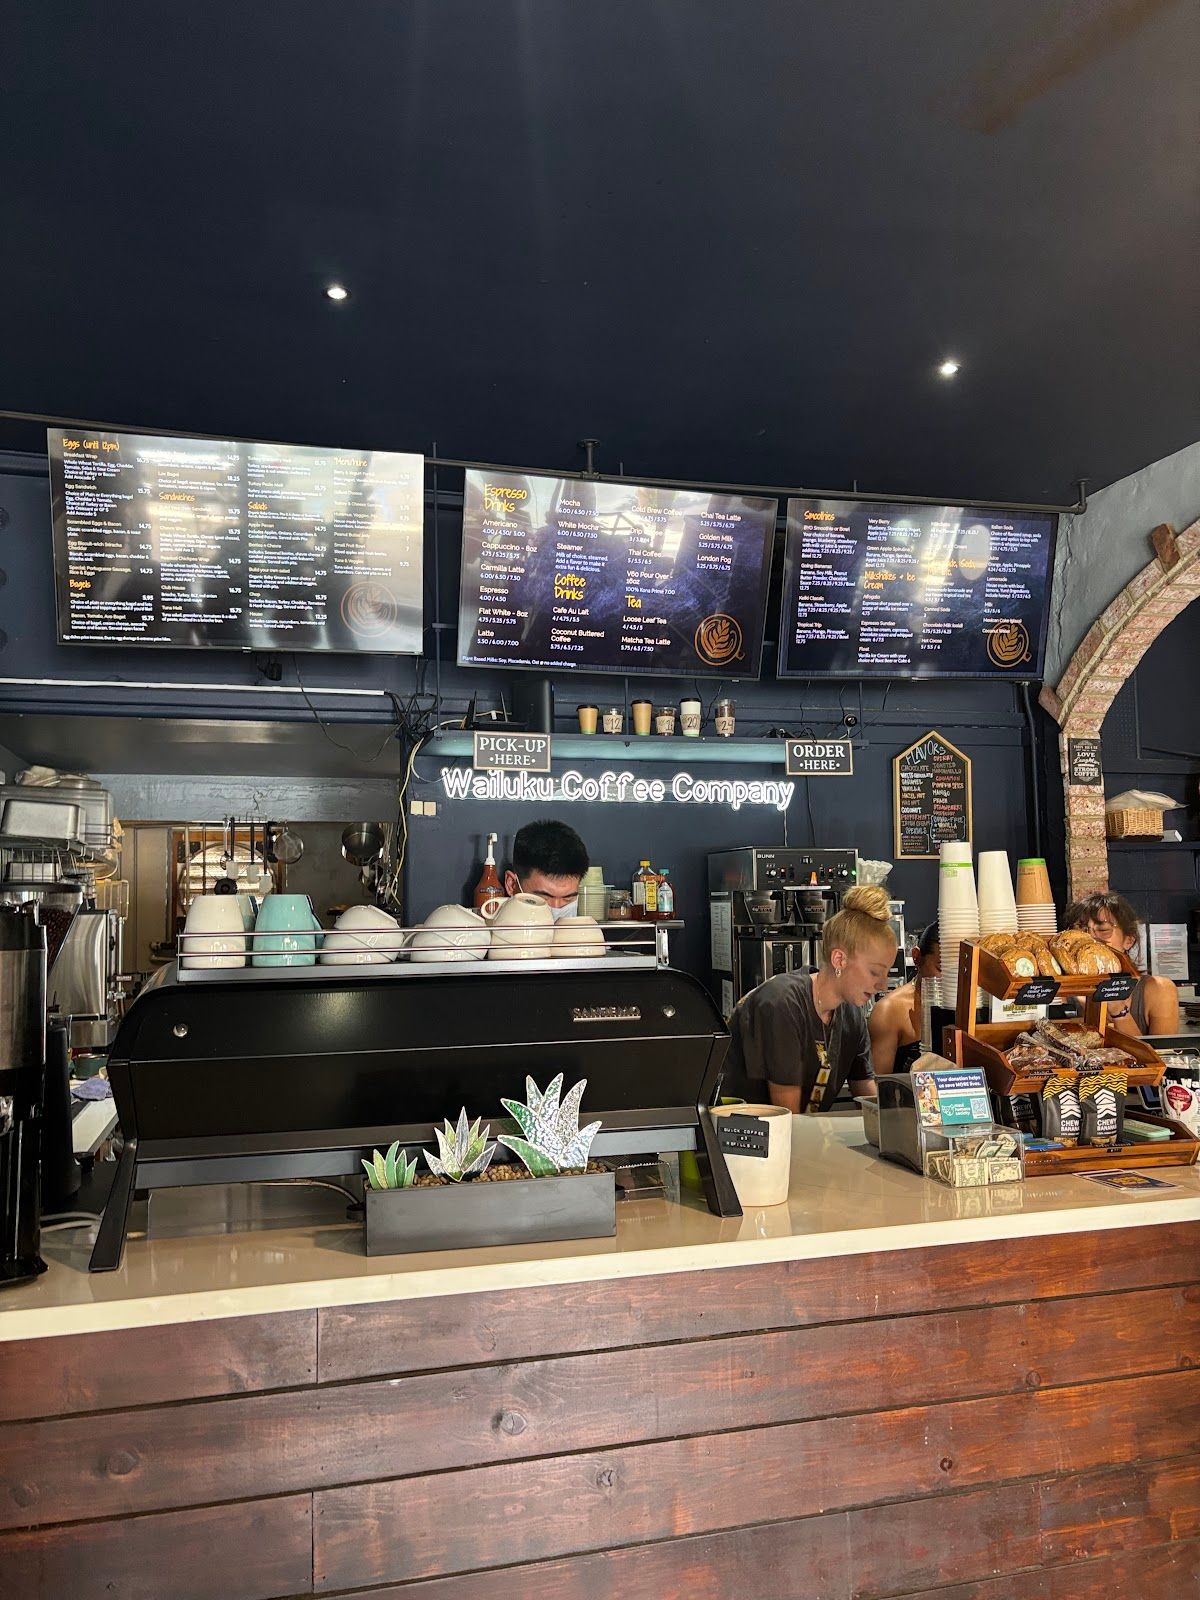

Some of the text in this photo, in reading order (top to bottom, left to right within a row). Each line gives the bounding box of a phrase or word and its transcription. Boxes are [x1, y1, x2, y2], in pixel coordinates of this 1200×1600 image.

[62, 438, 80, 450] Eggs
[83, 440, 99, 450] (until
[158, 492, 196, 502] Sandwiches
[484, 483, 528, 500] Espresso
[248, 501, 268, 510] Salads
[484, 498, 516, 512] Drinks
[560, 499, 581, 507] Mocha
[632, 505, 683, 516] Cold Brew Coffee
[804, 510, 836, 521] Smoothies
[700, 512, 742, 522] Chai Tea Latte
[482, 518, 518, 528] Americano
[557, 520, 599, 531] White Mocha
[698, 533, 734, 542] Golden Milk
[482, 542, 538, 553] Cappuccino 8oz
[556, 542, 583, 551] Steamer
[628, 548, 662, 558] Thai Coffee
[697, 554, 732, 565] London Fog
[508, 566, 525, 574] Latte
[640, 571, 654, 579] Pour
[655, 572, 669, 580] Over
[864, 570, 896, 581] Milkshakes
[69, 579, 92, 590] Bagels
[554, 573, 586, 587] Coffee
[864, 580, 884, 589] Cream
[479, 585, 509, 595] Espresso
[554, 585, 584, 600] Drinks
[624, 594, 642, 608] Tea
[478, 607, 528, 618] Flat White 8oz
[552, 606, 567, 614] Cafe
[578, 608, 590, 616] Lait
[623, 615, 667, 625] Loose Leaf Tea
[477, 629, 495, 637] Latte
[551, 628, 605, 638] Coconut Buttered
[550, 635, 572, 643] Coffee
[621, 636, 671, 646] Matcha Tea Latte
[610, 718, 620, 730] 12
[686, 717, 698, 728] 20
[722, 720, 734, 731] 24
[479, 736, 546, 752] PICK-UP
[792, 744, 846, 758] ORDER
[906, 740, 947, 765] FLAVORS
[494, 754, 531, 766] HERE
[804, 760, 836, 770] HERE
[441, 768, 795, 810] Wailuku Coffee Company
[1097, 1118, 1117, 1126] CHEWY
